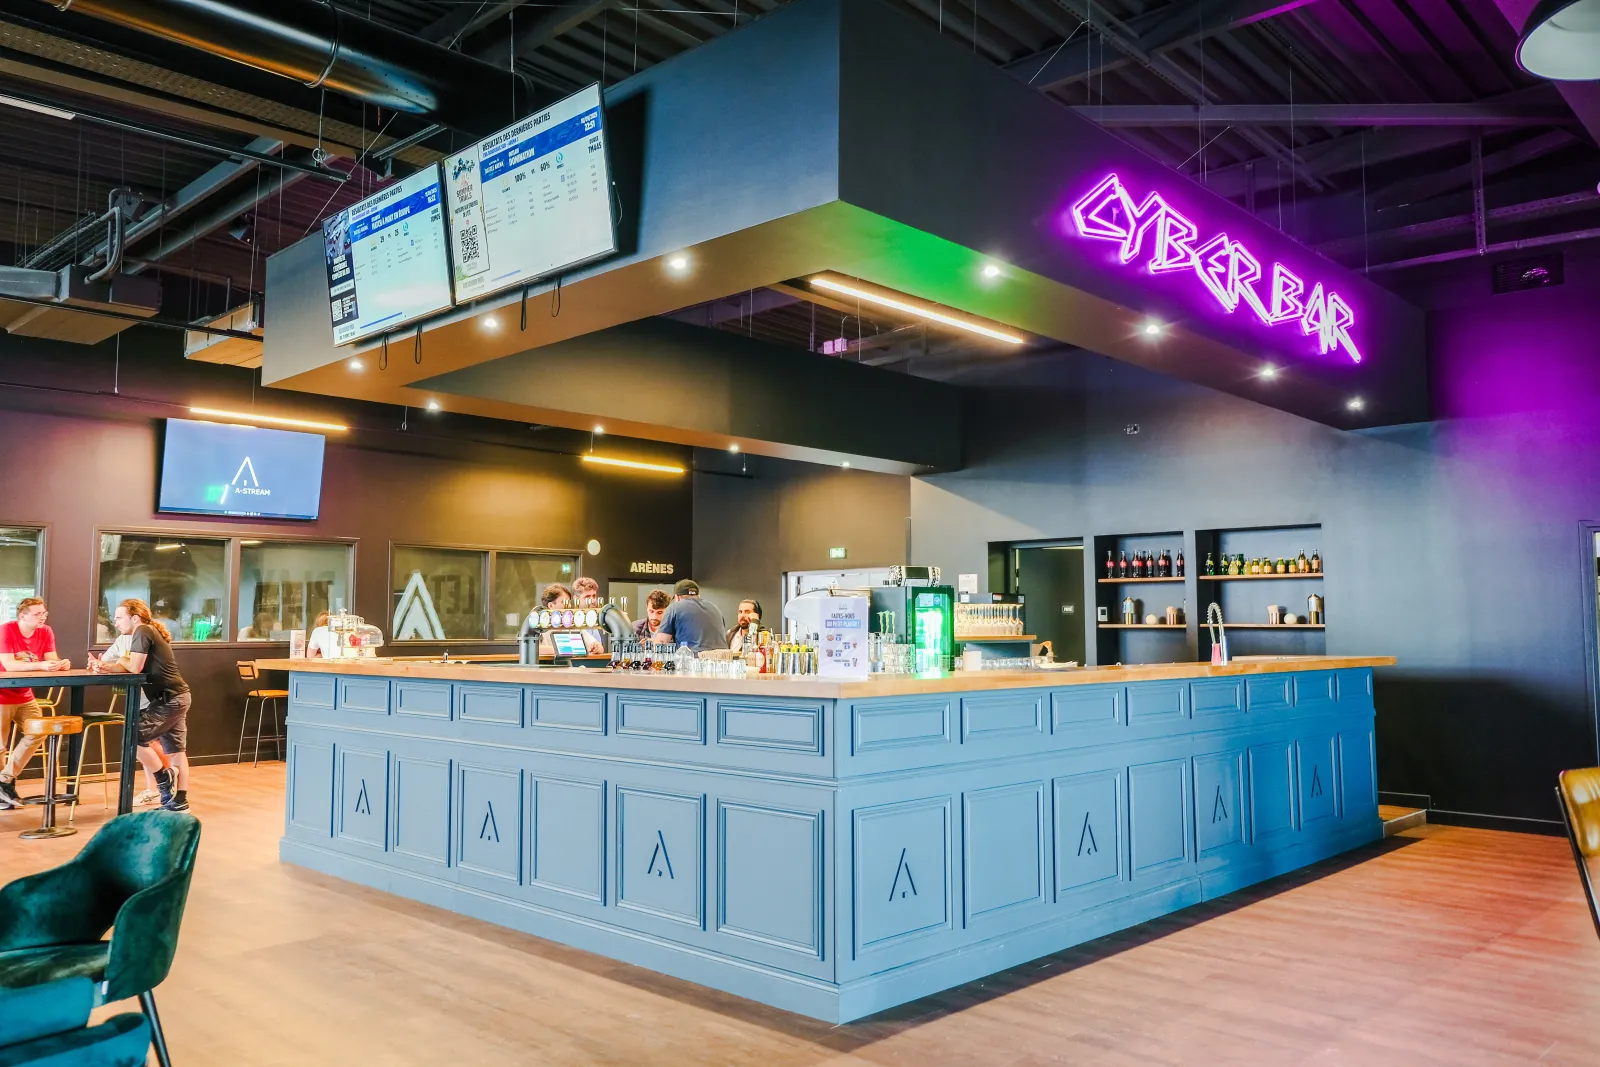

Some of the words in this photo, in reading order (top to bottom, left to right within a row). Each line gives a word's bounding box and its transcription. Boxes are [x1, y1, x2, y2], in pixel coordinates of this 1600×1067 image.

[1072, 172, 1271, 326] CYBER
[1268, 261, 1361, 363] BAR
[234, 487, 271, 496] A-STREAM
[630, 560, 674, 574] ARÈNES
